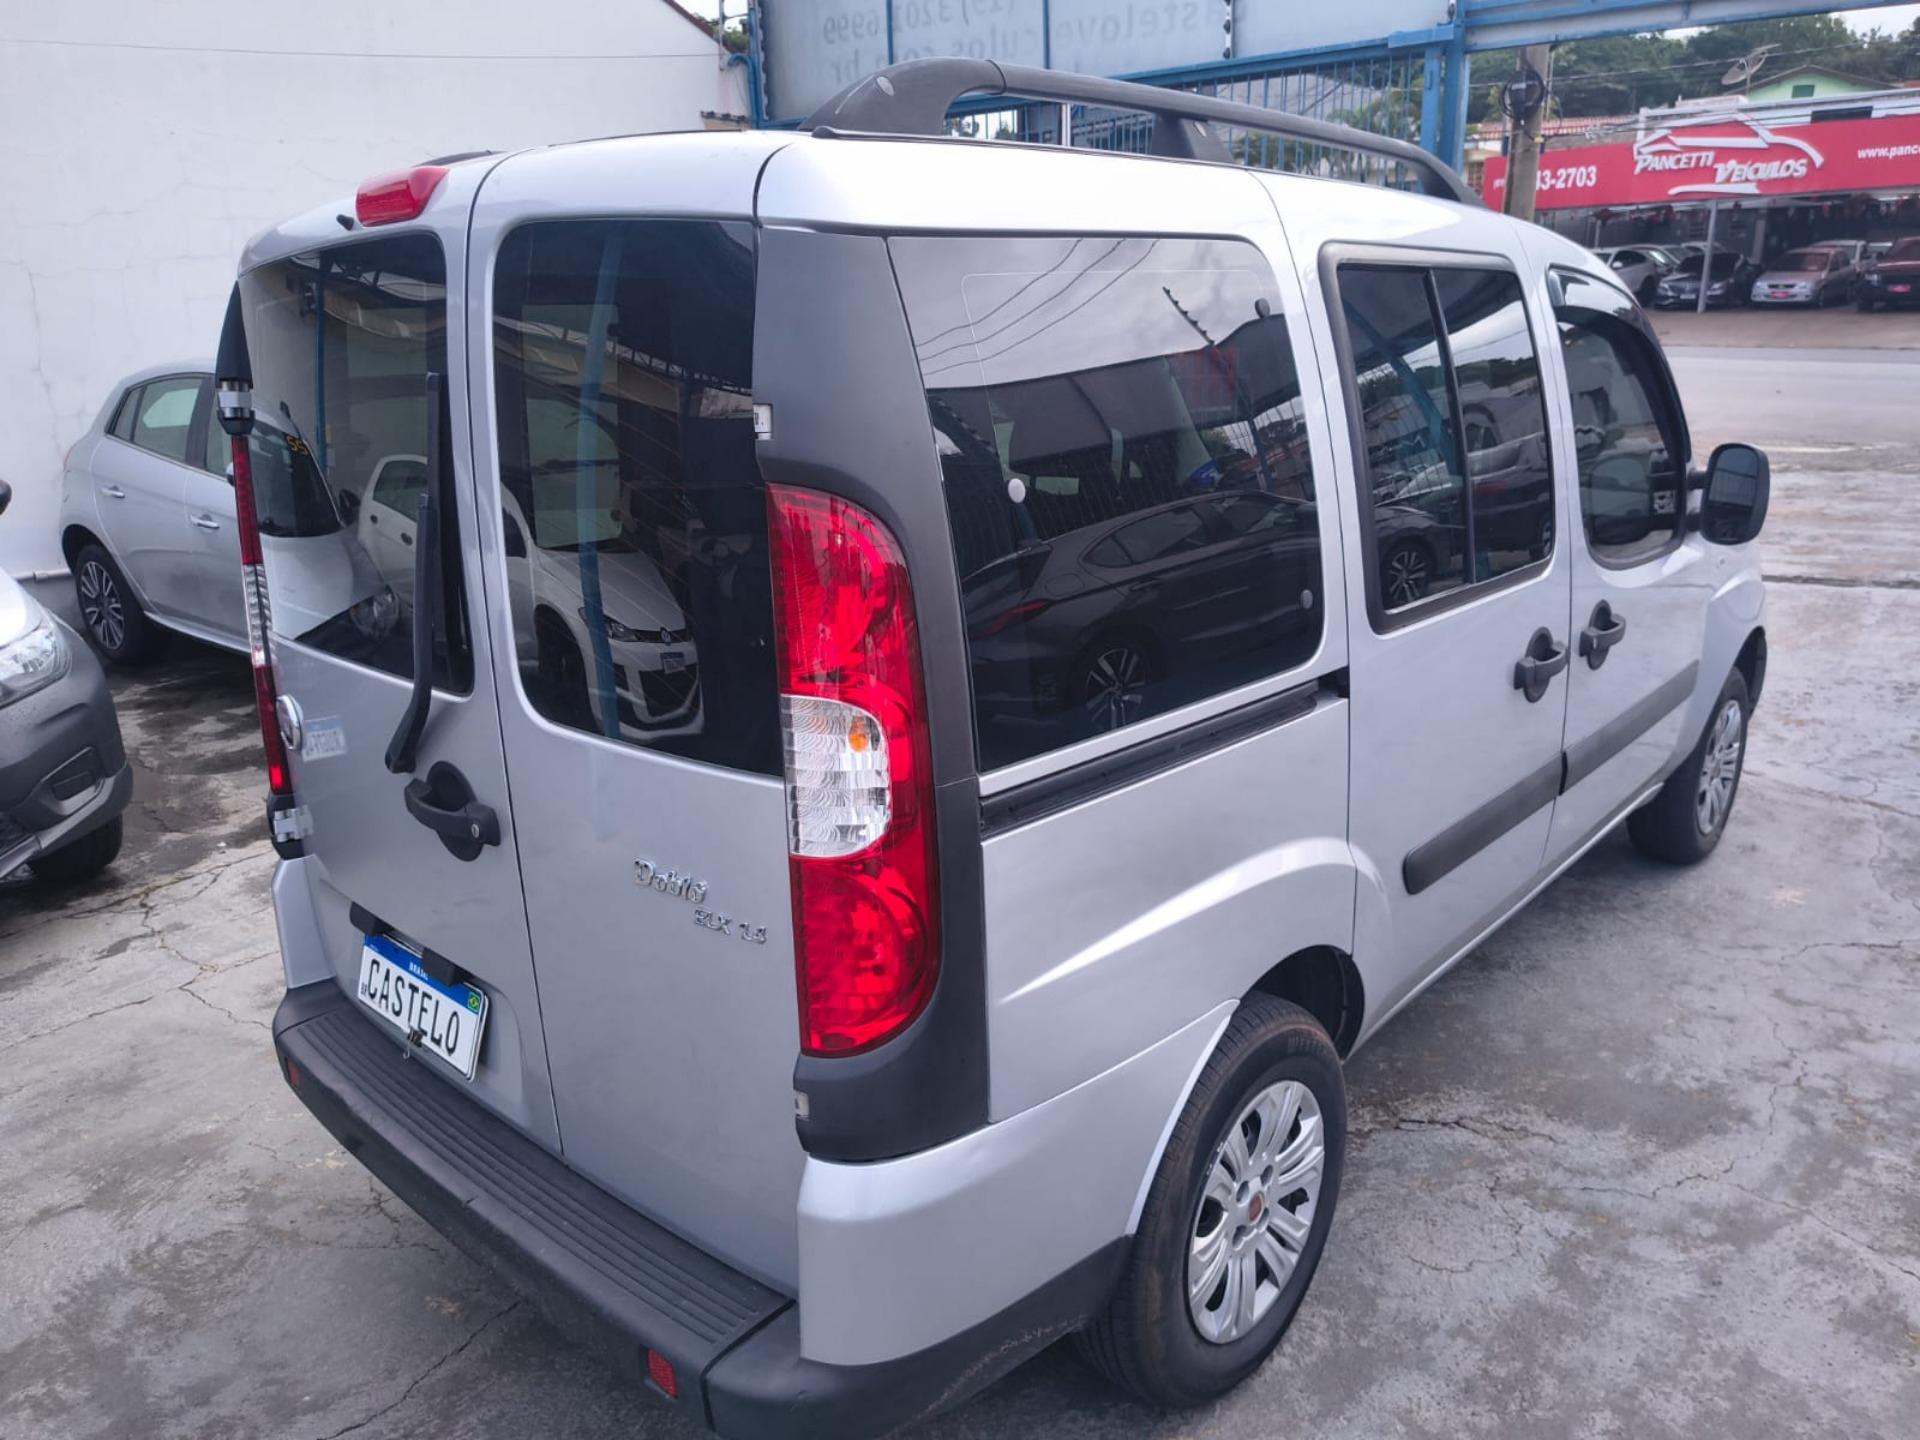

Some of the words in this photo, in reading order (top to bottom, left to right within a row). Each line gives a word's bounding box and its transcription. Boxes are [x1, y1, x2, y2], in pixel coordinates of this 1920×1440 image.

[1633, 150, 1715, 176] PANCETTI
[1858, 144, 1920, 160] www.panc
[367, 958, 460, 1057] CASTELO
